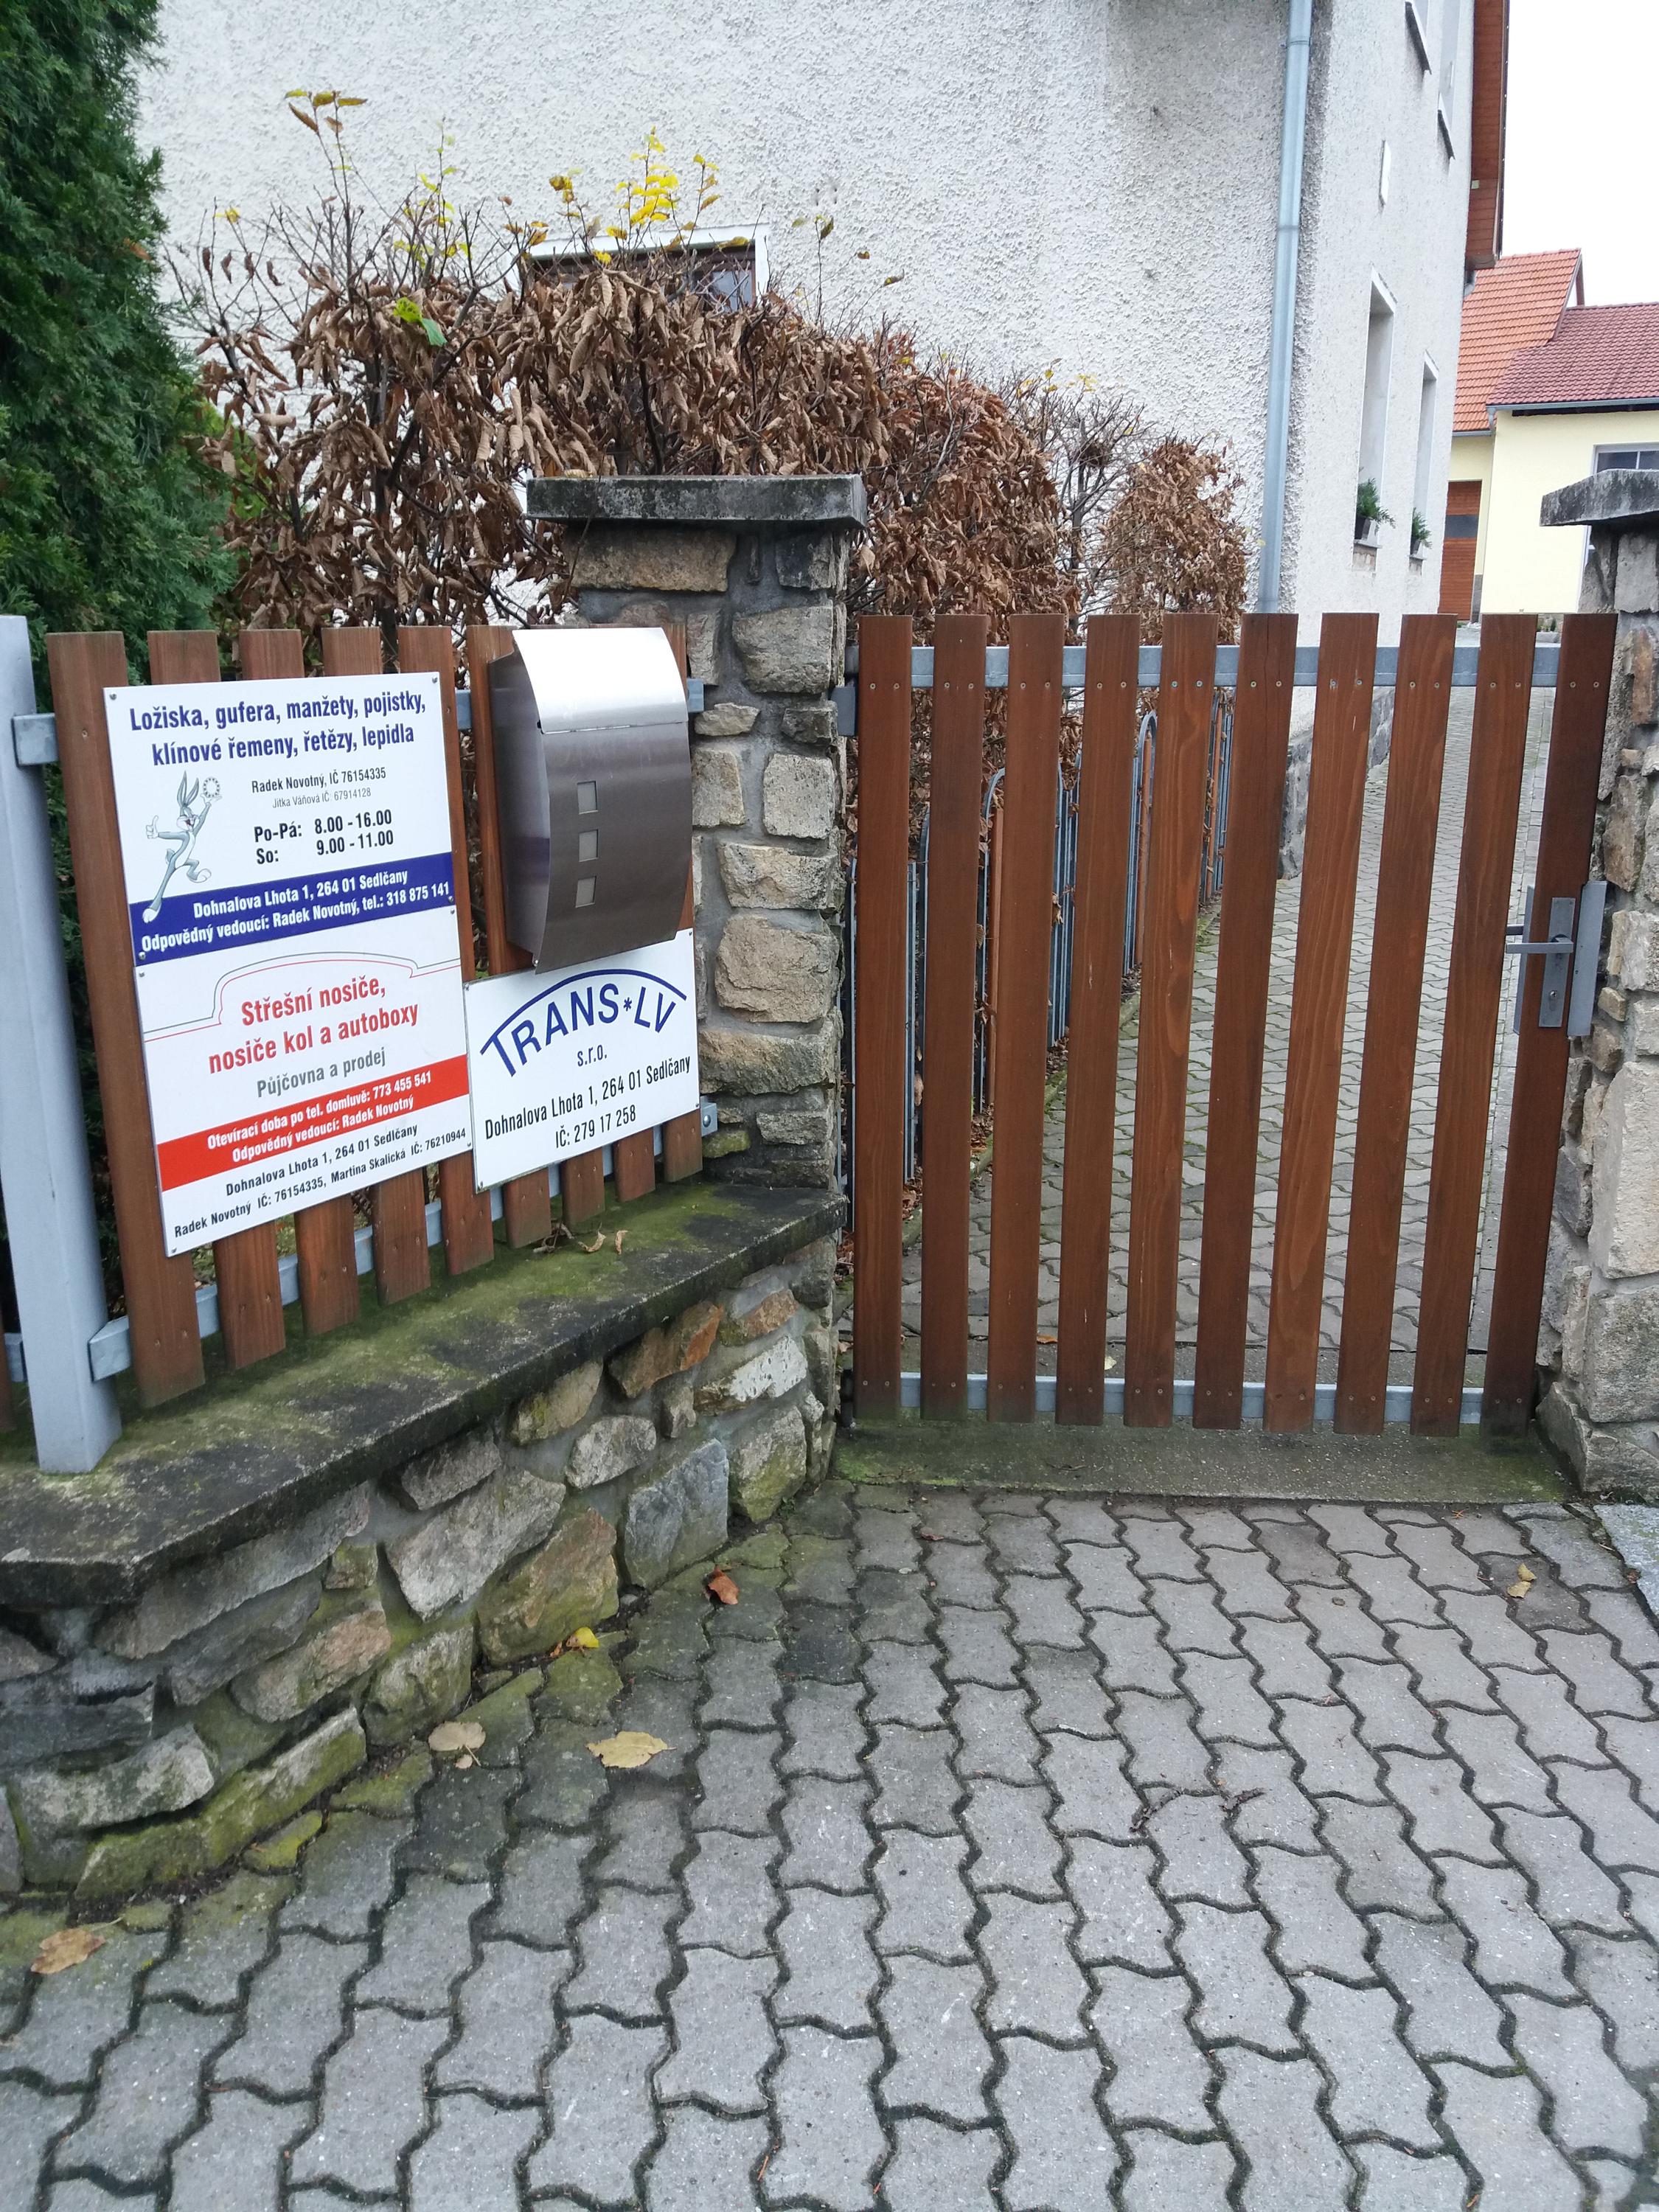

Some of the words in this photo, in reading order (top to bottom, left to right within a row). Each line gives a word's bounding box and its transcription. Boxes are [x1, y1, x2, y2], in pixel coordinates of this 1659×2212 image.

[130, 704, 209, 730] Ložiska,
[216, 700, 281, 728] gufera,
[287, 695, 358, 721] manžety,
[364, 690, 425, 718] pojistky,
[152, 737, 222, 765] klínové
[229, 737, 298, 759] řemeny,
[304, 729, 357, 753] řetězy,
[363, 723, 414, 747] lepidla
[252, 779, 283, 793] Radek
[286, 773, 327, 789] Novotný,
[330, 769, 338, 785] IČ
[342, 767, 386, 783] 76154335
[273, 798, 291, 808] Jitka
[293, 793, 320, 805] Váňová
[334, 787, 372, 801] 67914128
[254, 821, 302, 842] Po-Pá:
[314, 815, 343, 834] 8.00
[355, 809, 392, 829] 16.00
[257, 848, 279, 864] So:
[316, 836, 345, 855] 9.00
[358, 830, 394, 849] 11.00
[142, 925, 214, 953] Odpovědný
[217, 915, 270, 938] vedoucí:
[273, 910, 310, 928] Radek
[313, 902, 359, 924] Novotný,
[362, 894, 383, 911] tel.:
[386, 892, 407, 907] 318
[409, 888, 428, 903] 875
[431, 882, 450, 897] 141
[193, 895, 261, 919] Dohnalova
[264, 888, 299, 906] Lhota
[302, 886, 314, 902] 1,
[316, 881, 339, 897] 264
[342, 878, 356, 892] 01
[359, 870, 408, 889] Sedlčany
[241, 987, 313, 1026] Střešní
[319, 975, 386, 1008] nosiče,
[209, 1040, 276, 1074] nosiče
[284, 1025, 313, 1054] kol
[321, 1026, 331, 1044] a
[338, 1003, 419, 1040] autoboxy
[577, 1045, 607, 1067] s.r.o.
[257, 1066, 324, 1098] Půjčovna
[330, 1061, 338, 1077] a
[344, 1047, 386, 1077] prodej
[485, 1105, 547, 1139] Dohnalova
[552, 1091, 583, 1118] Lhota
[588, 1086, 598, 1107] 1,
[602, 1076, 625, 1100] 264
[629, 1070, 641, 1090] 01
[647, 1056, 691, 1085] Sedlčany
[207, 1125, 259, 1150] Otevírací
[261, 1114, 288, 1138] doba
[291, 1111, 304, 1129] po
[306, 1104, 323, 1119] tel.
[327, 1090, 370, 1114] domluvě:
[372, 1084, 392, 1101] 773
[394, 1077, 412, 1093] 455
[414, 1071, 431, 1087] 541
[232, 1130, 293, 1163] Odpovědný
[296, 1118, 340, 1143] vedoucí:
[342, 1108, 374, 1128] Radek
[376, 1096, 414, 1119] Novotný
[574, 1119, 596, 1144] 279
[600, 1114, 611, 1134] 17
[616, 1105, 636, 1127] 258
[175, 1217, 208, 1238] Radek
[211, 1203, 251, 1224] Novotný
[274, 1176, 327, 1204] 76154335,
[331, 1163, 366, 1183] Martina
[369, 1148, 406, 1171] Skalická
[425, 1128, 466, 1151] 76210944
[226, 1167, 285, 1196] Dohnalova
[289, 1155, 319, 1176] Lhota
[322, 1152, 333, 1166] 1,
[335, 1144, 355, 1161] 264
[358, 1138, 369, 1154] 01
[374, 1124, 418, 1147] Sedlčany
